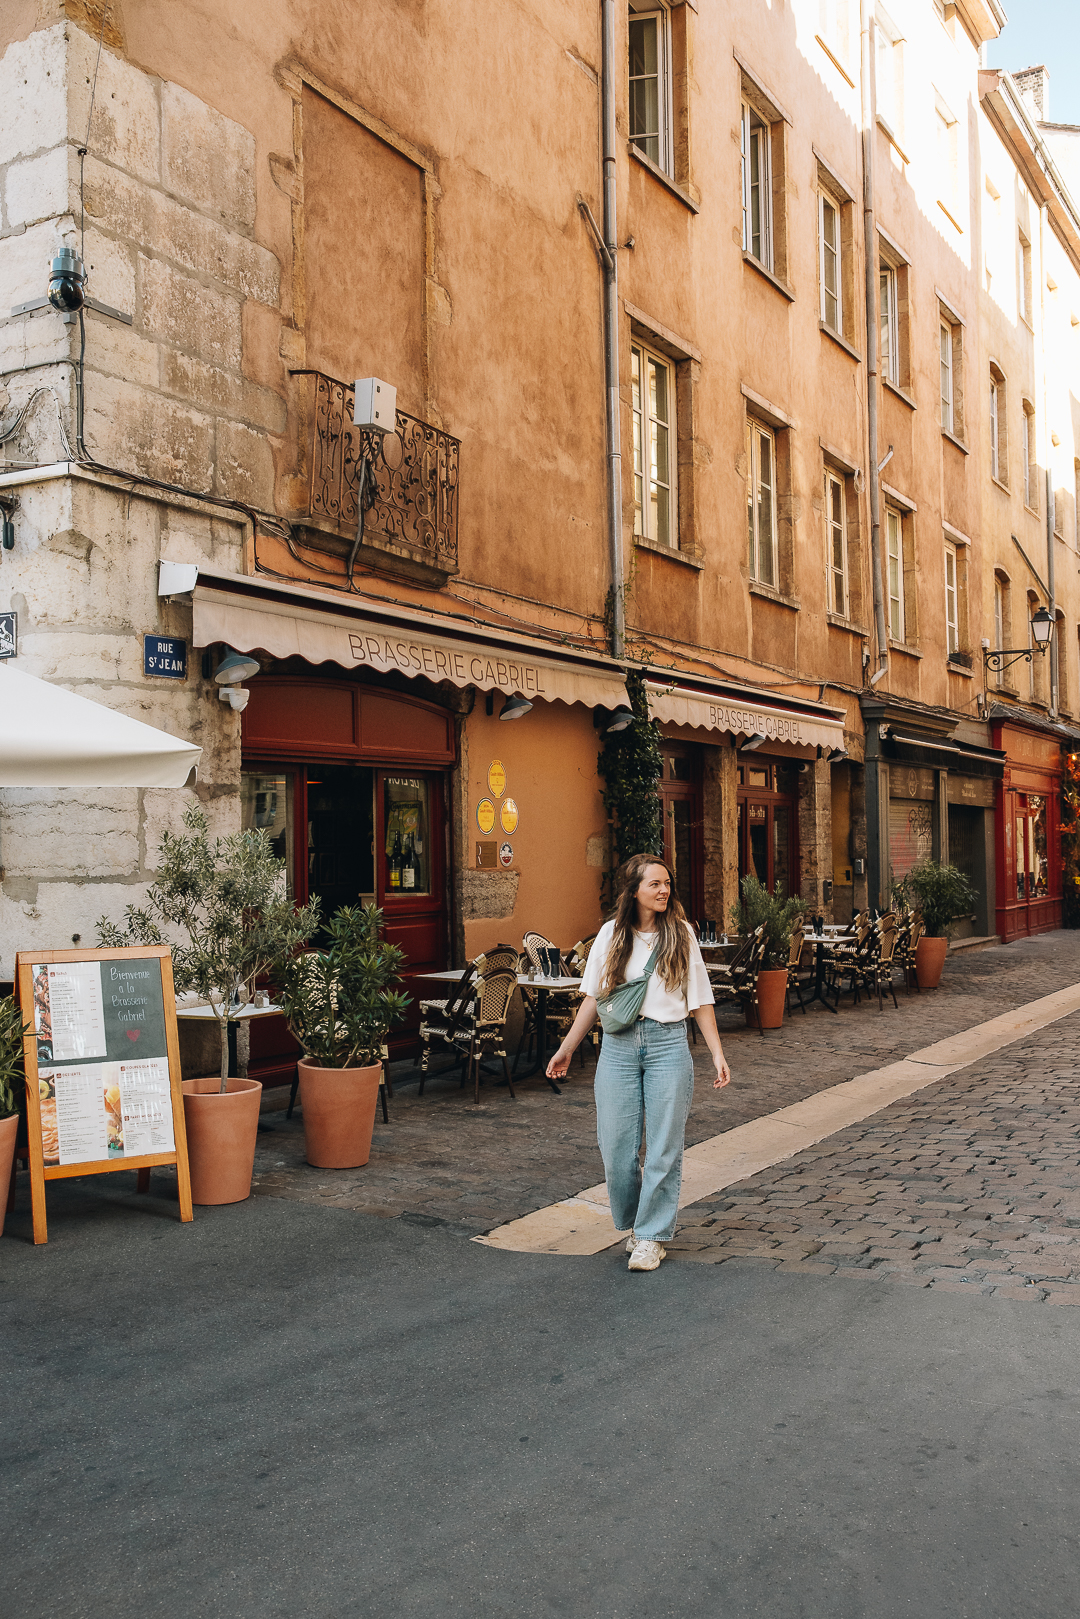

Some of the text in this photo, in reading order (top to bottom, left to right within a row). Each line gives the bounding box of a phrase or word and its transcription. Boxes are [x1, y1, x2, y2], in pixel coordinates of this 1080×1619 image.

[157, 642, 174, 654] RUE
[158, 658, 183, 672] JEAN
[347, 633, 546, 694] BRASSERIE GABRIEL
[709, 705, 803, 740] BRASSERIE GABRIEL
[110, 966, 151, 981] Bienvenue
[126, 981, 135, 994] la
[111, 994, 148, 1007] Brasserie
[117, 1008, 147, 1021] Gabriel
